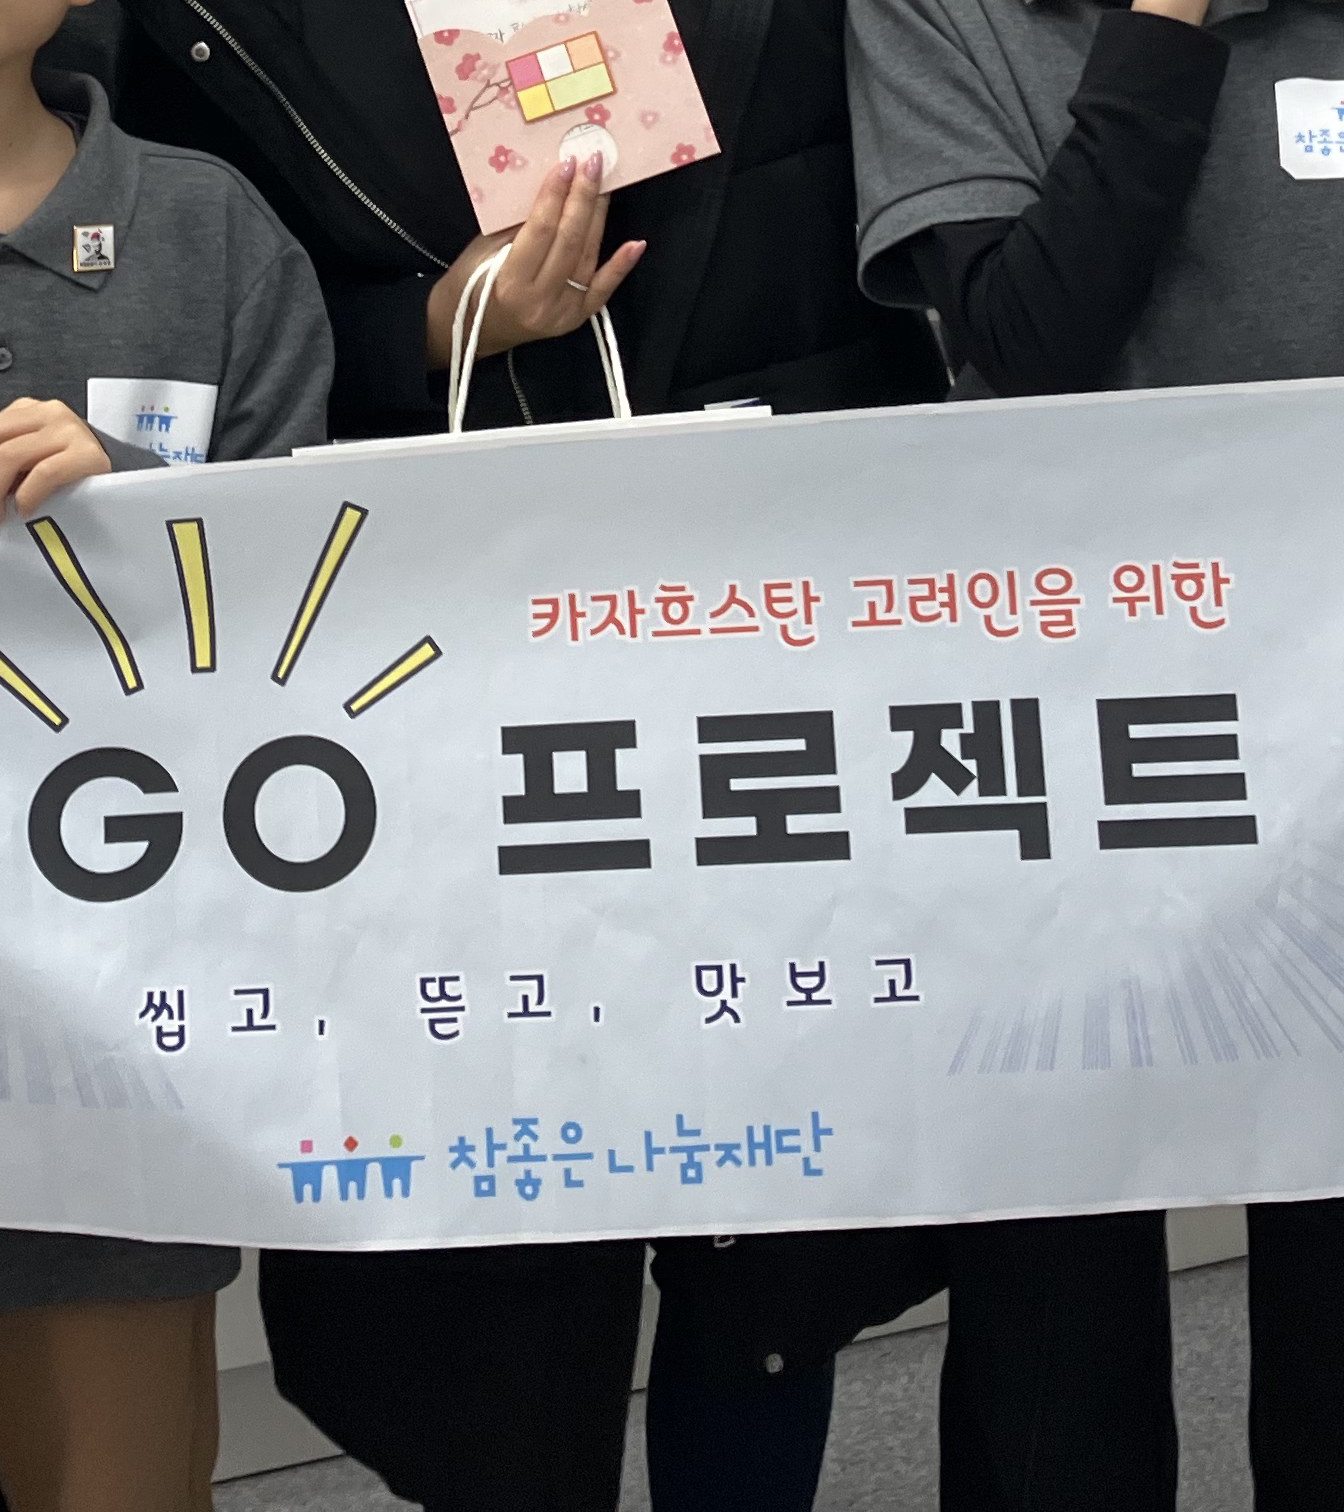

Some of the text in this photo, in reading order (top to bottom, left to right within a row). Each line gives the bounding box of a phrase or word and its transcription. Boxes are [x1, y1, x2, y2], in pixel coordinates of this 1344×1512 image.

[530, 560, 1231, 648] 카자흐스탄 고려인을 위한
[26, 734, 378, 904] GO
[496, 692, 1260, 877] 프로젝트
[694, 957, 921, 1025] 맛보고
[446, 1110, 835, 1203] 참좋은나눔재단
